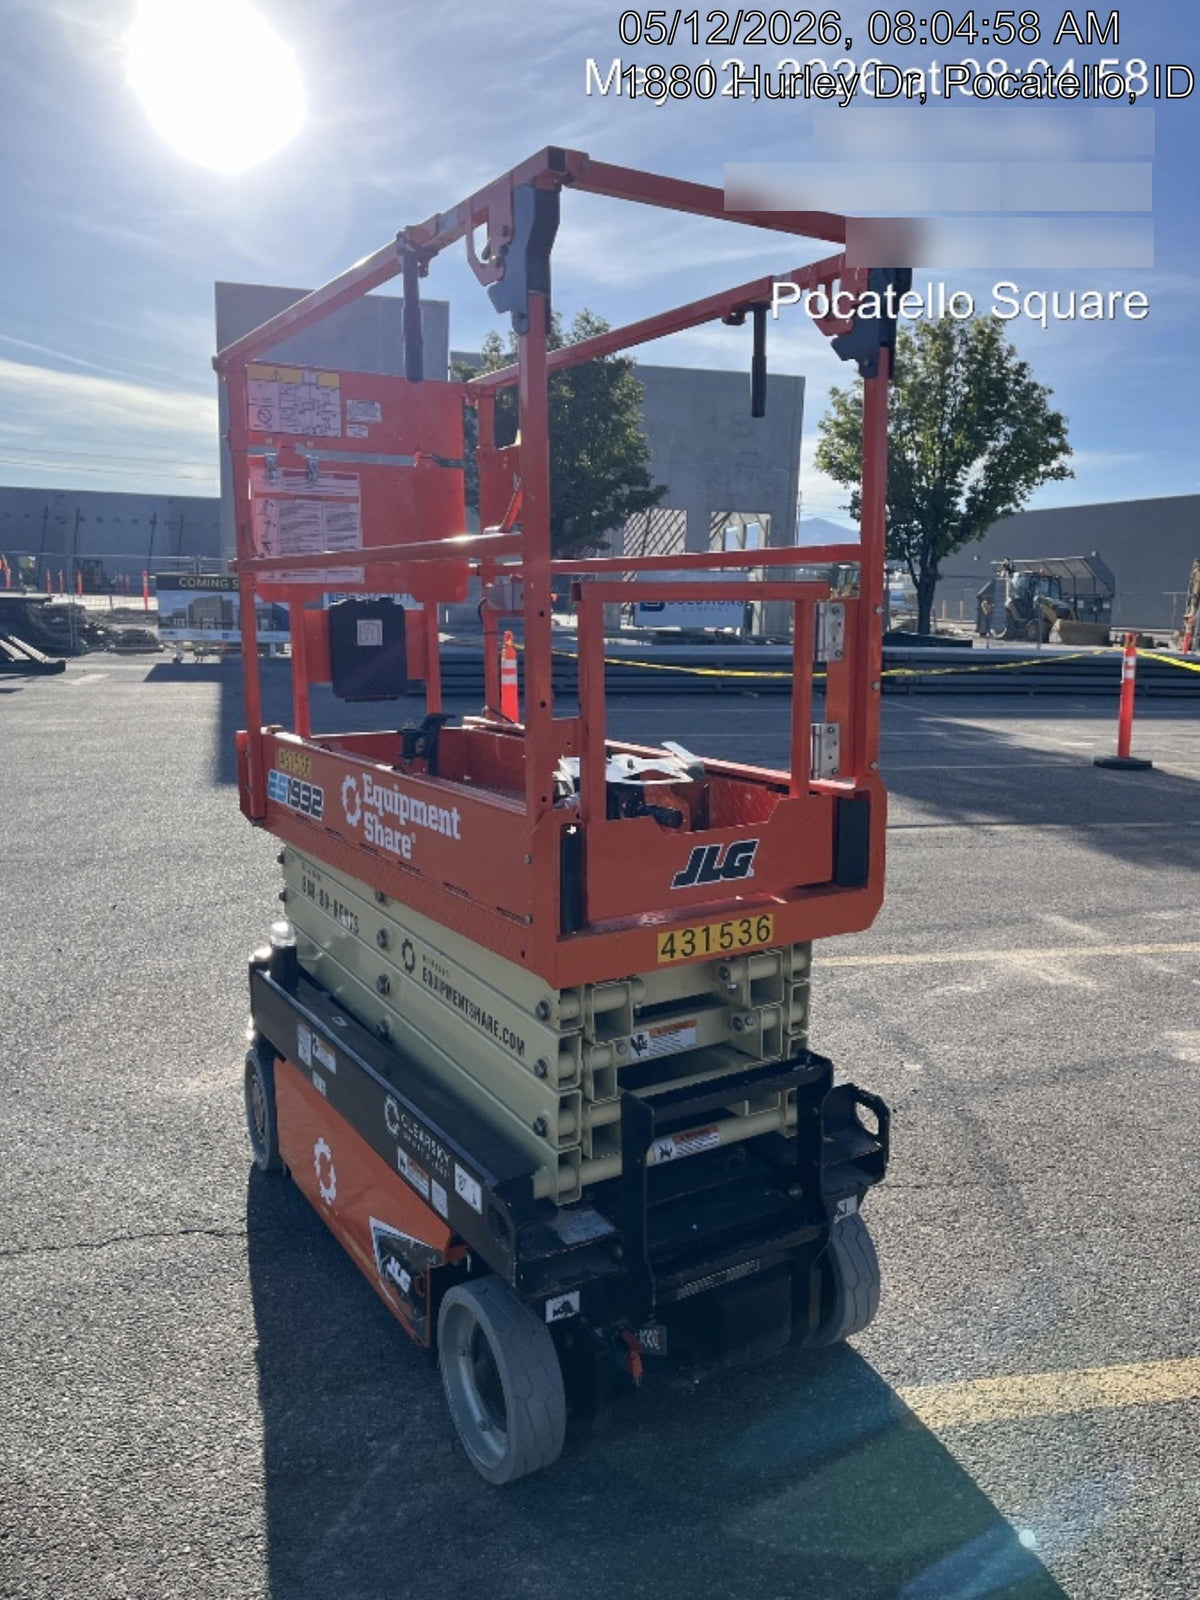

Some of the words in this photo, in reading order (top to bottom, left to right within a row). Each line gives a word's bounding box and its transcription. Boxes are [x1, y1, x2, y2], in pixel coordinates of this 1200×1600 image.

[179, 577, 229, 589] COMING
[268, 769, 324, 821] ES1932
[362, 773, 461, 840] Equipment
[363, 811, 413, 859] Share
[670, 838, 760, 889] JLG
[660, 914, 771, 959] 431536
[422, 966, 525, 1057] EQUIPMENTSHARE.COM
